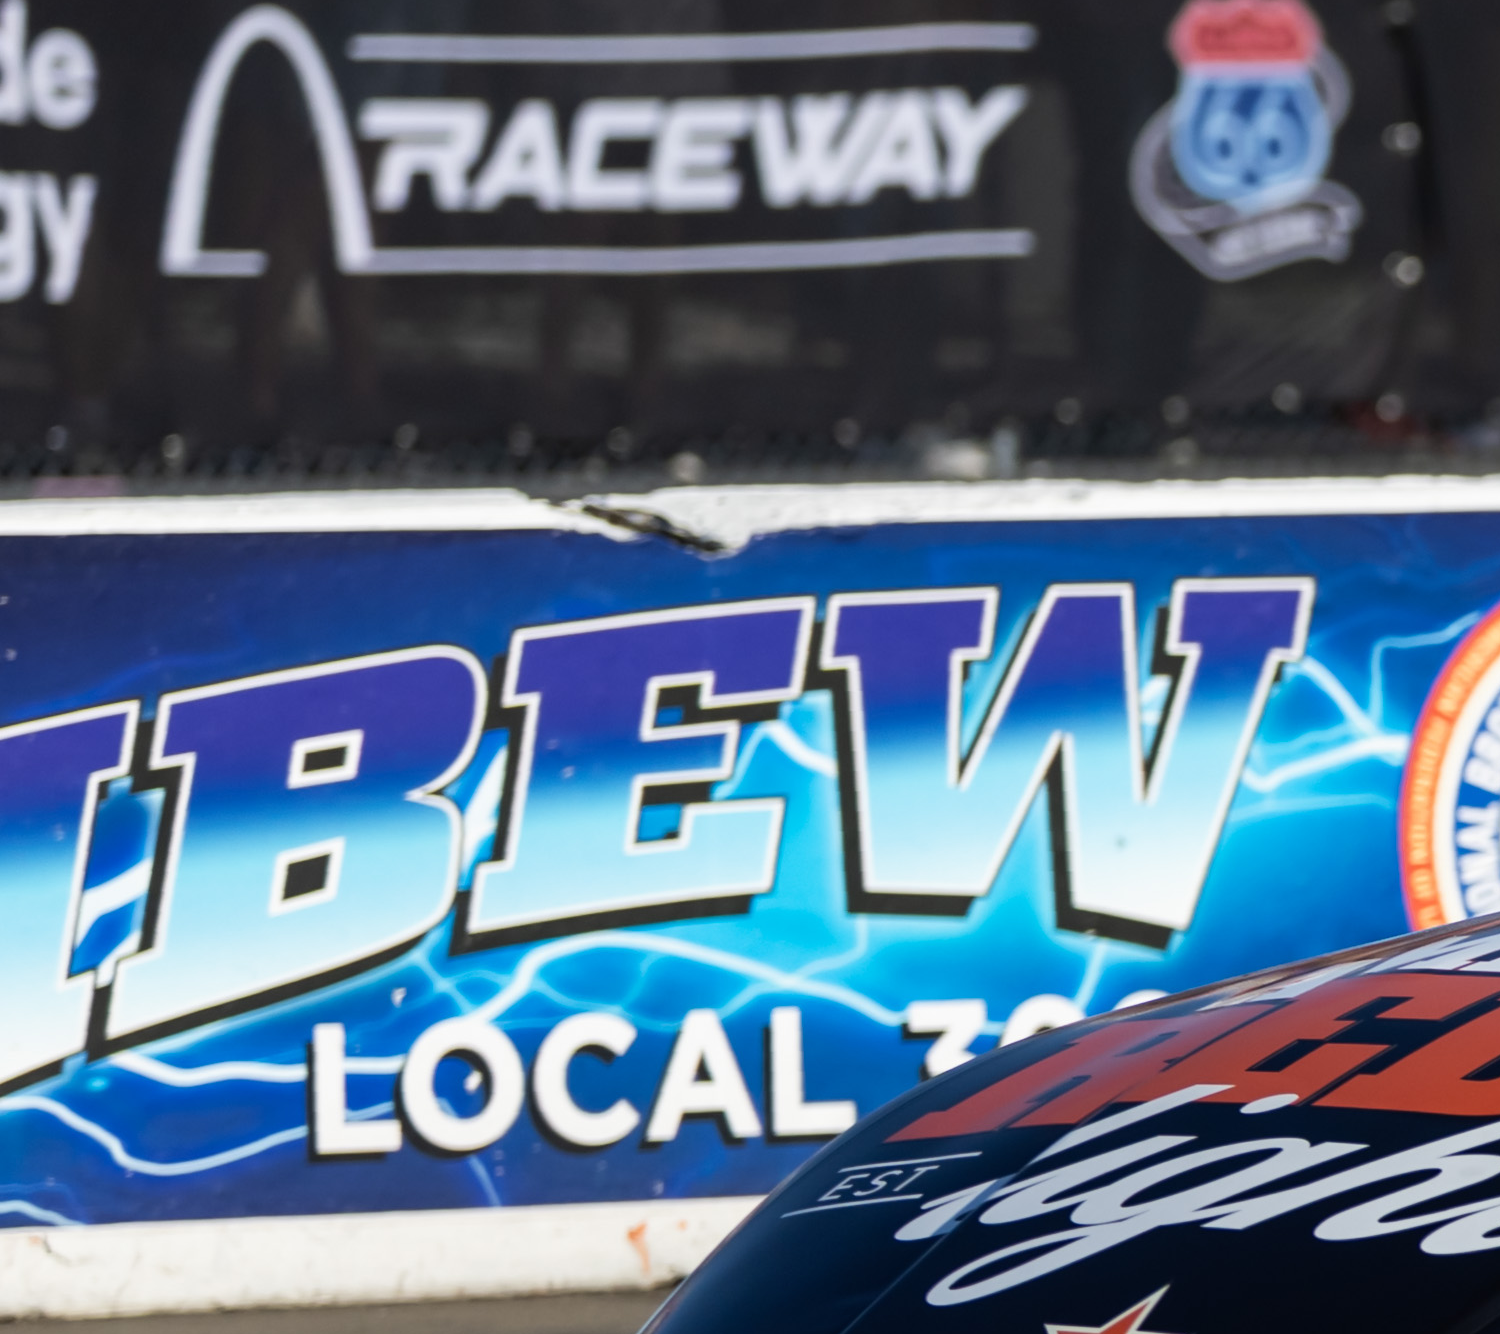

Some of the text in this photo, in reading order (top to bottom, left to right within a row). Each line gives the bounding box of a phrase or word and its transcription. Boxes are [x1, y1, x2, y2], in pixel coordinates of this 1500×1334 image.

[355, 84, 1028, 211] RACEWAY
[0, 575, 1317, 1097] IBEW
[310, 1007, 858, 1157] LOCAL
[817, 1163, 941, 1202] EST
